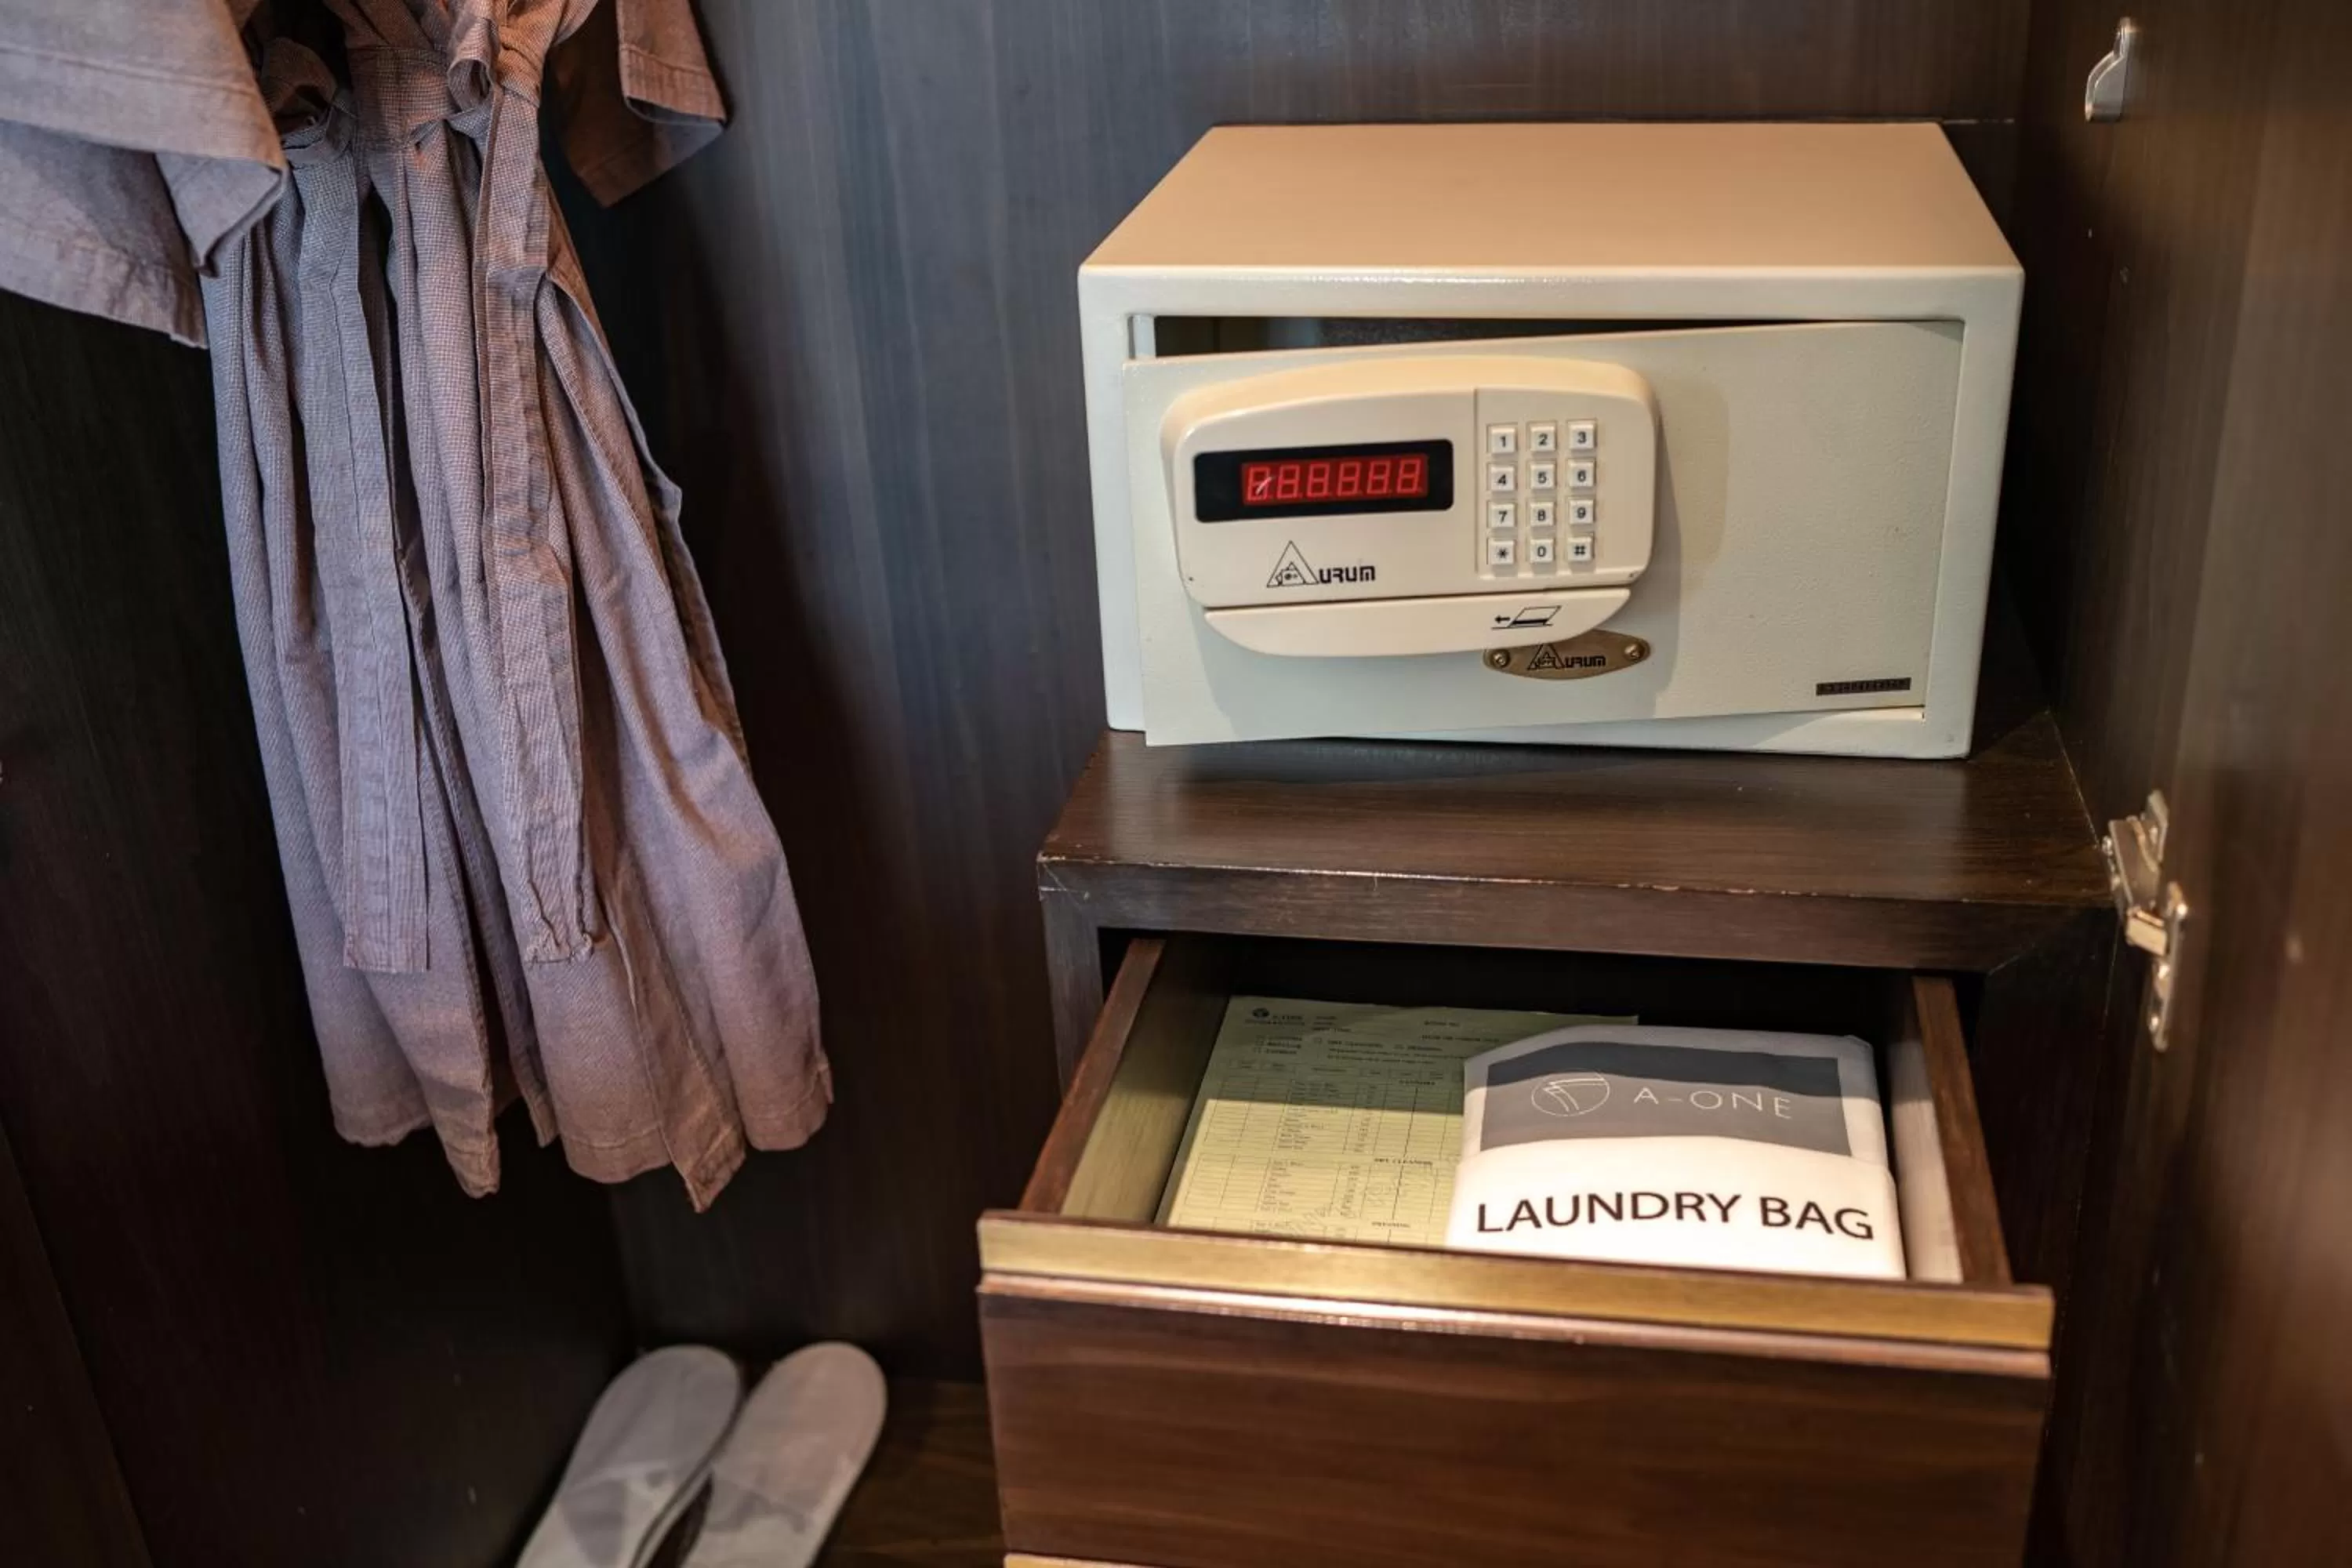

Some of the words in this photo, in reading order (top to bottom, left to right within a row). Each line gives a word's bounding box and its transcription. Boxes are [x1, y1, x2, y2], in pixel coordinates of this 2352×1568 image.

[1499, 435, 1507, 448] 1
[1538, 433, 1548, 446] 2
[1577, 431, 1587, 444] 3
[1497, 474, 1507, 486] 4
[1537, 471, 1547, 484] 5
[1577, 470, 1587, 482] 6
[1498, 510, 1508, 523] 7
[1537, 509, 1547, 521] 8
[1577, 506, 1587, 519] 9
[1537, 545, 1547, 557] 0
[1633, 1086, 1792, 1120] A-ONE
[1476, 1192, 1742, 1233] LAUNDRY
[1759, 1196, 1875, 1241] BAG
